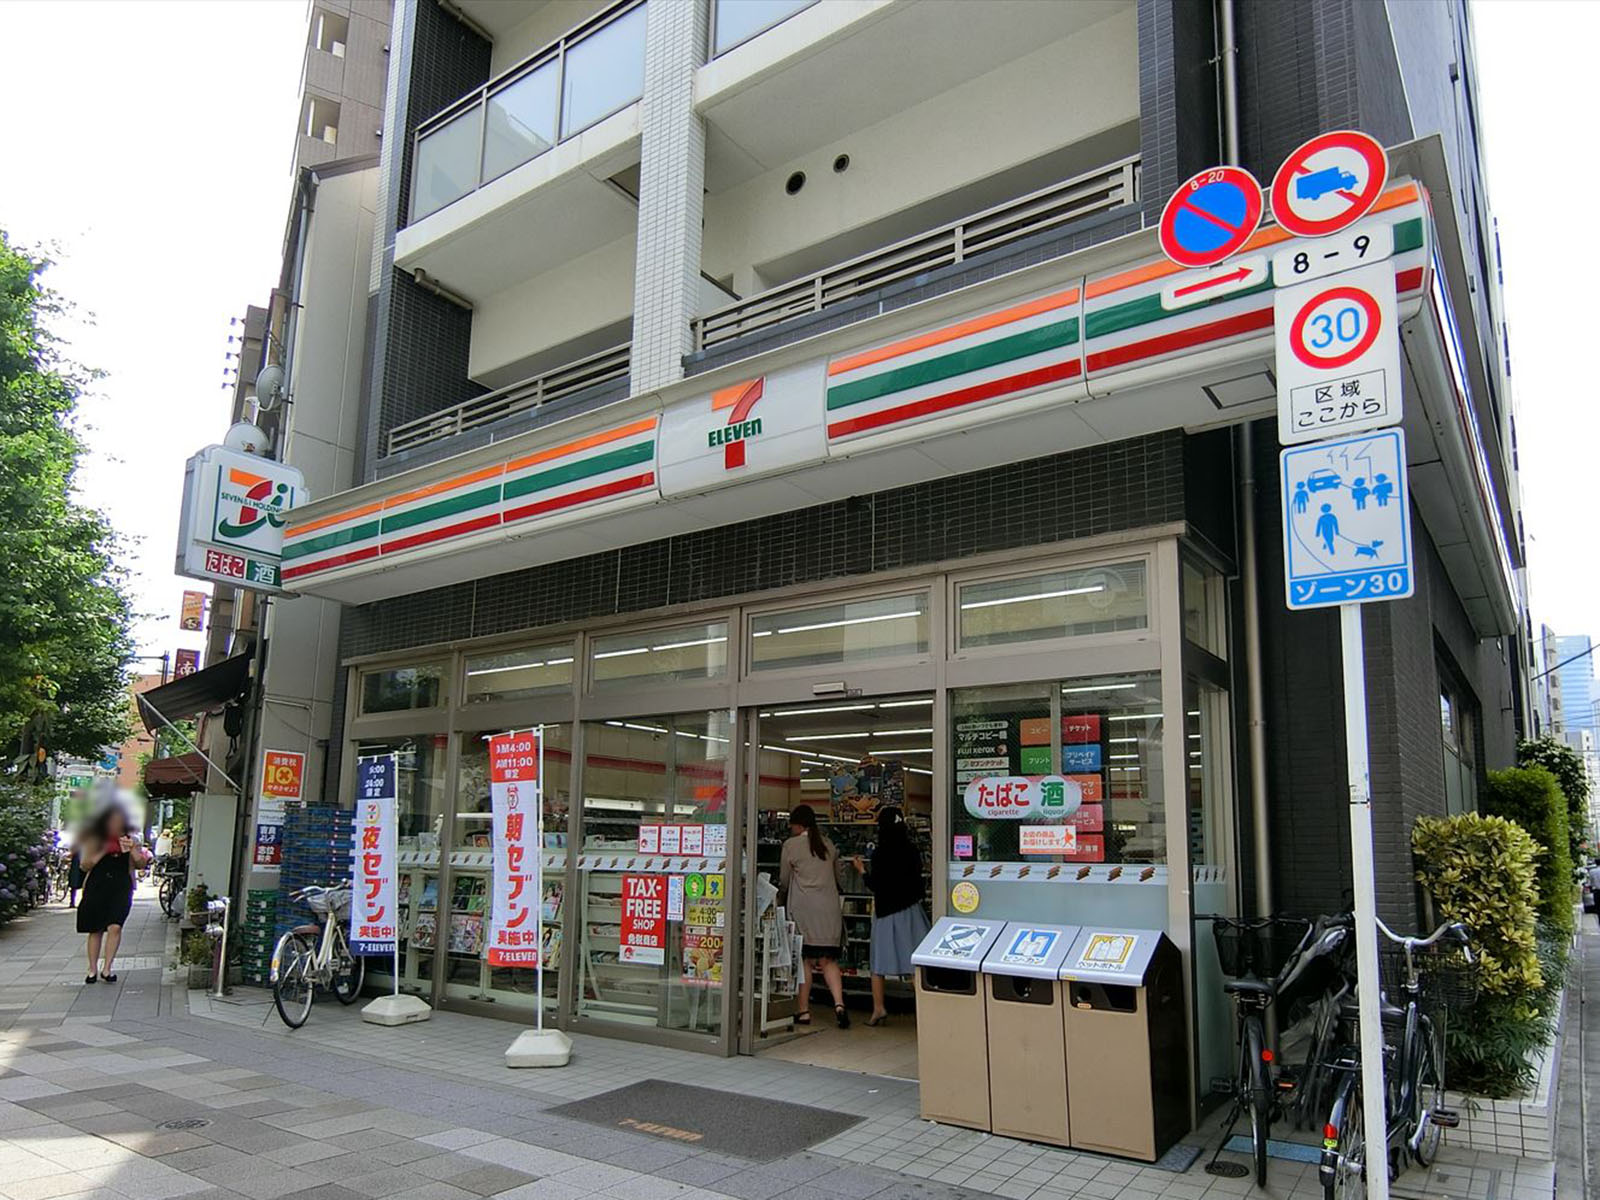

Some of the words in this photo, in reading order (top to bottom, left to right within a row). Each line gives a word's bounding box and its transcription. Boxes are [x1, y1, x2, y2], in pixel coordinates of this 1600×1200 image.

[1190, 170, 1225, 191] 8-20
[1310, 307, 1361, 349] 30
[1315, 379, 1361, 403] 区域
[1298, 398, 1381, 428] ここから
[206, 551, 243, 577] たばこ
[254, 561, 276, 584] 酒
[1295, 571, 1404, 602] ゾーン30
[1068, 725, 1092, 733] チケット
[978, 783, 1030, 808] たばこ
[1040, 781, 1065, 807] 酒
[988, 808, 1019, 817] cigarette
[505, 812, 532, 929] 朝セブン
[626, 899, 662, 919] FREE
[632, 919, 656, 931] SHOP
